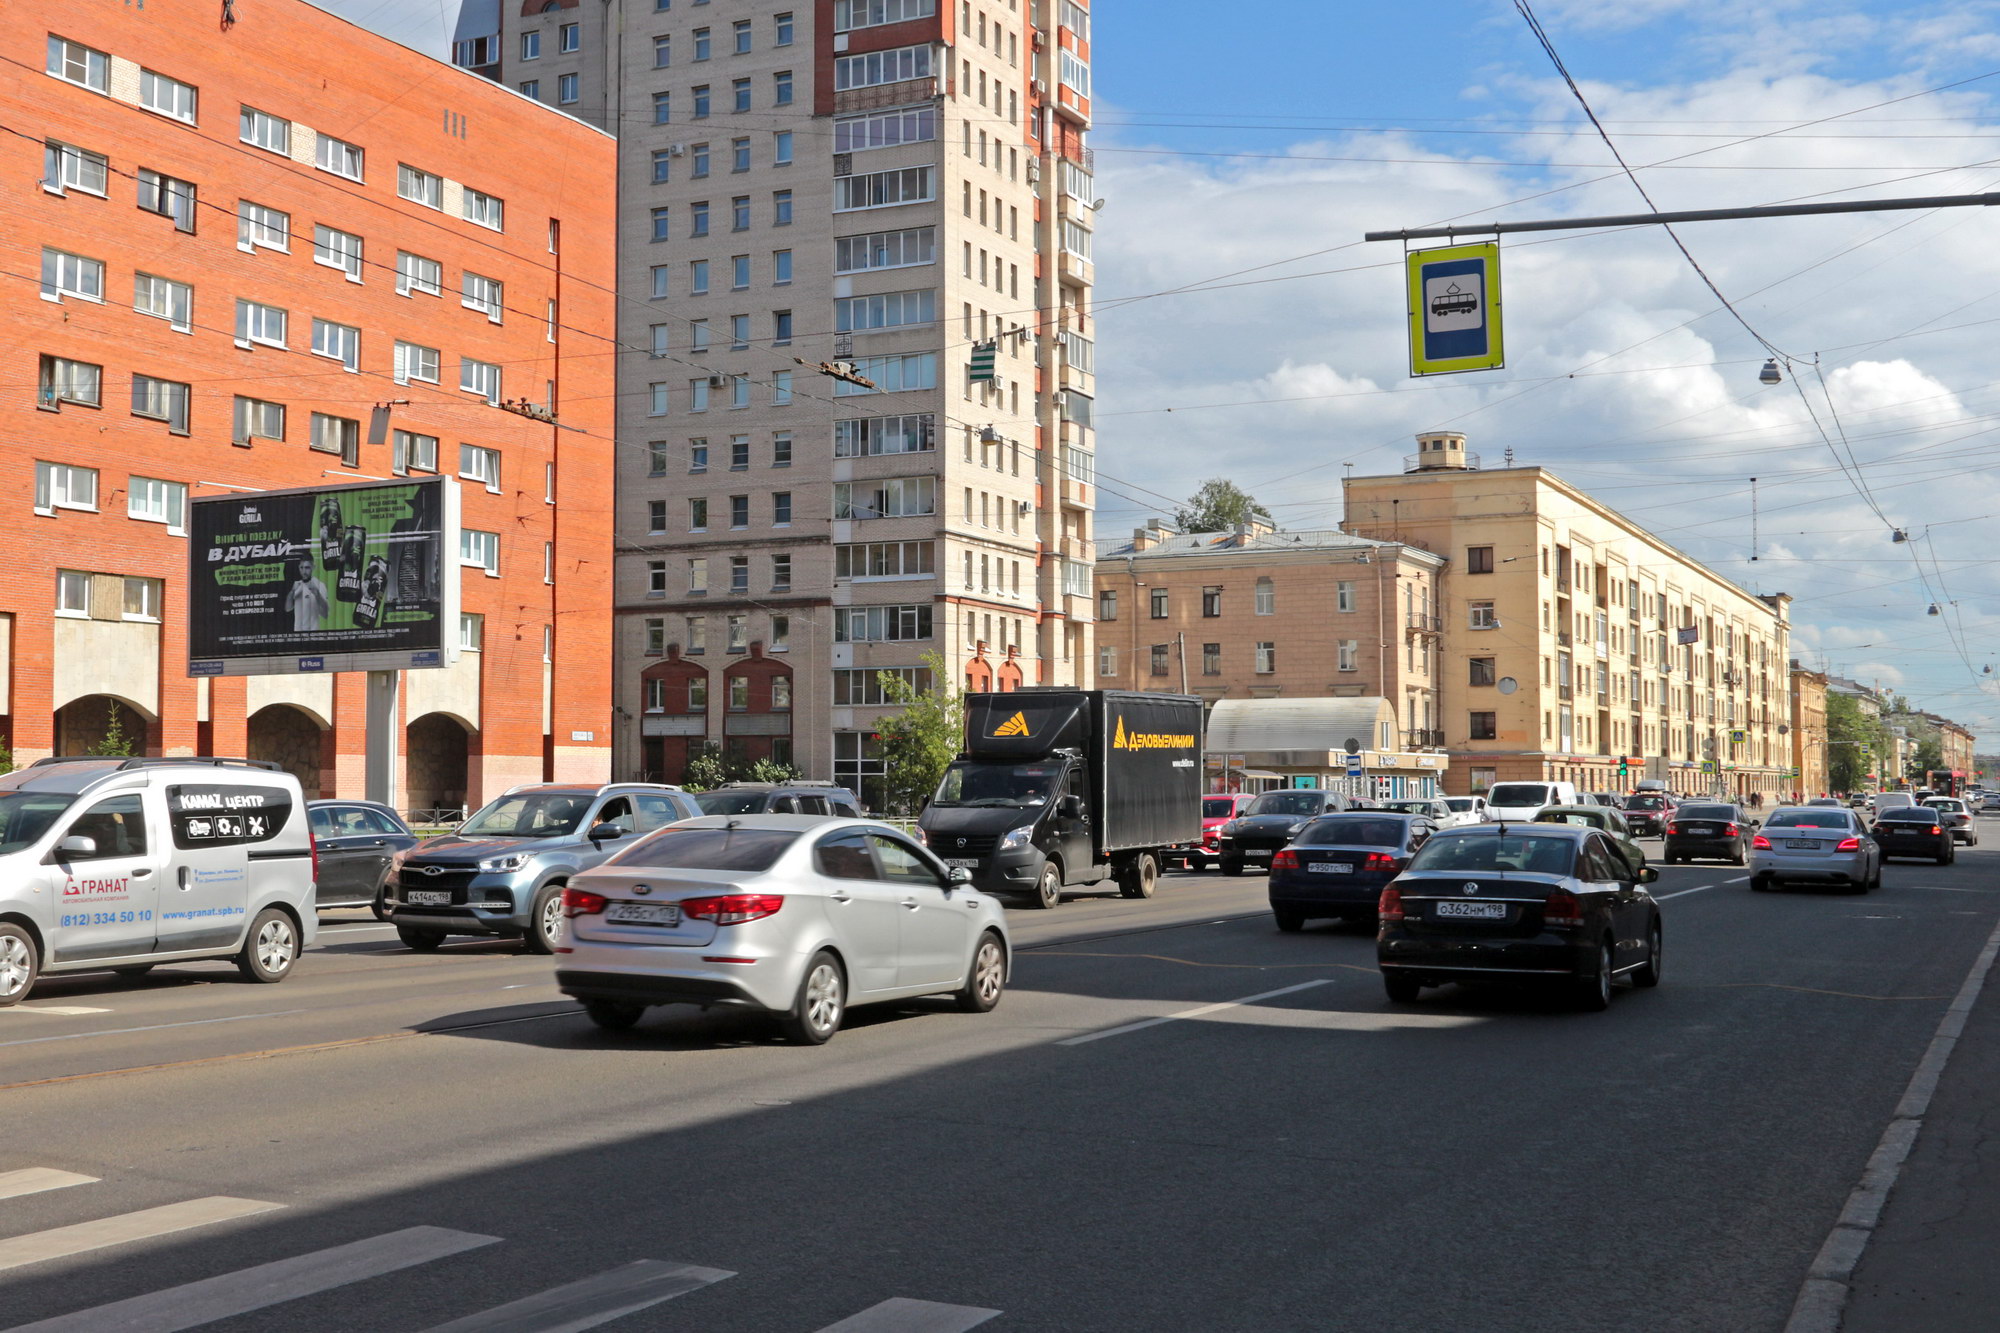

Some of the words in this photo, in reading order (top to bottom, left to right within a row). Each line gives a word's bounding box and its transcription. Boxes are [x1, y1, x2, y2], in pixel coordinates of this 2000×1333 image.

[207, 547, 223, 562] В
[224, 538, 292, 562] ДУБАЙ
[180, 793, 224, 810] KAMAZ
[224, 795, 264, 810] ЦЕНТР
[82, 878, 129, 895] ГРАНАТ
[162, 906, 245, 920] www.granat.spb.ru
[1440, 903, 1485, 915] О362НМ
[1487, 904, 1503, 914] 198
[61, 913, 90, 928] (812)
[94, 912, 116, 925] 334
[120, 911, 134, 923] 50
[138, 910, 151, 921] 10
